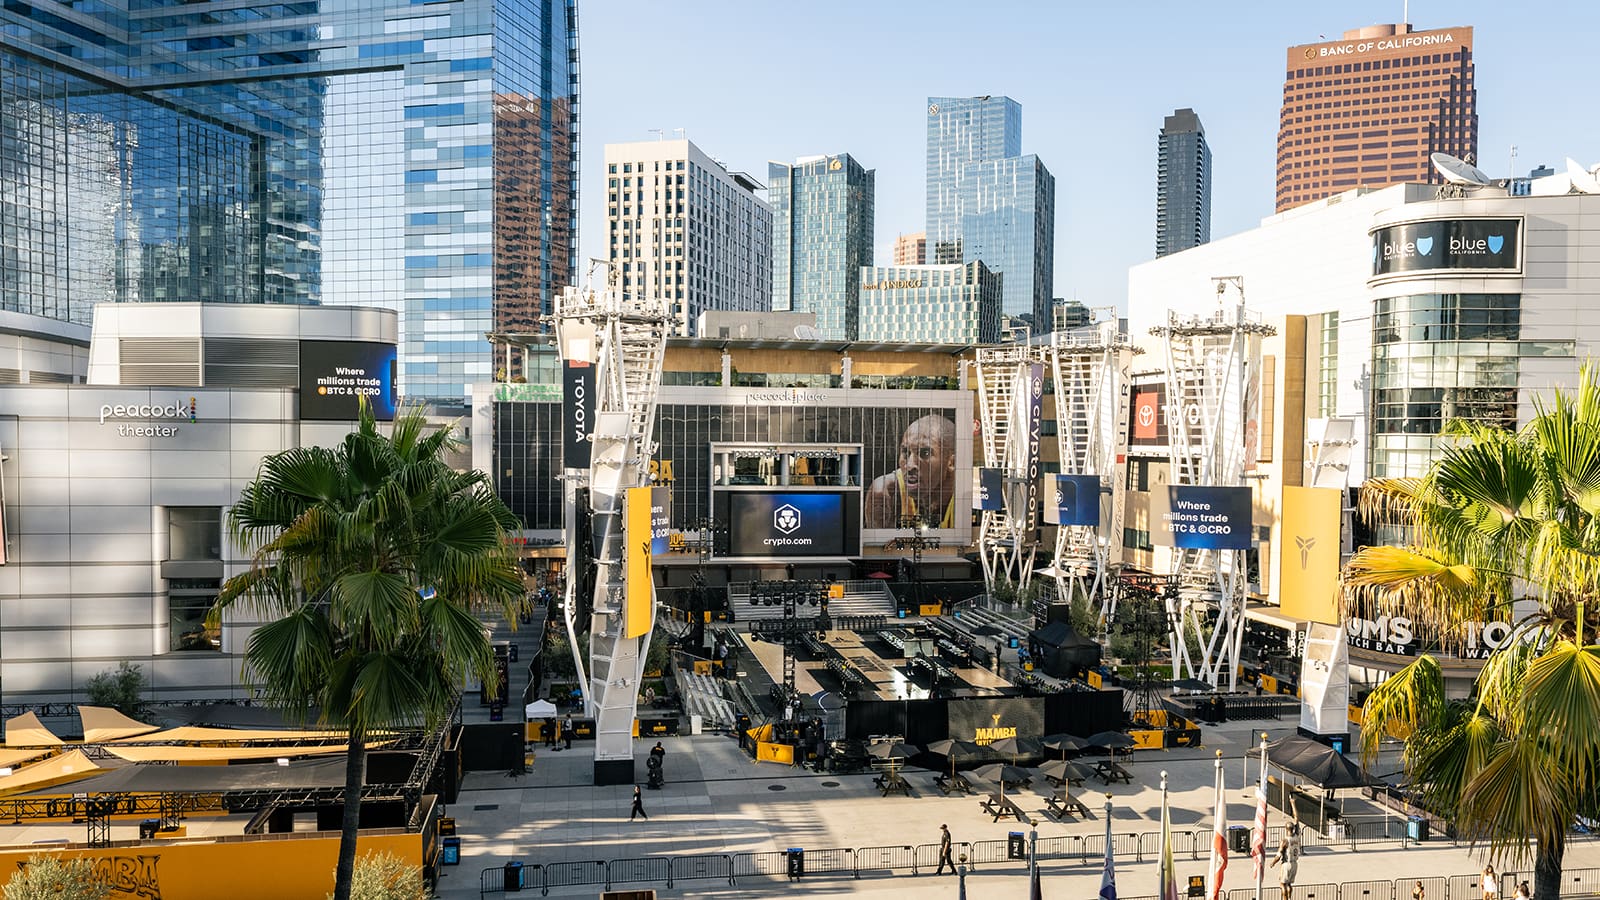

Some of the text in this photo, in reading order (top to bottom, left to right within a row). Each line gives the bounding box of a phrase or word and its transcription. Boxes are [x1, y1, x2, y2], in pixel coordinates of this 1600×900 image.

[1320, 33, 1454, 57] BANC OF CALIFORNIA
[1384, 240, 1416, 256] blue
[1449, 235, 1487, 250] blue
[887, 279, 923, 289] INDIGO
[335, 367, 366, 376] Where
[317, 376, 381, 386] millions trade
[327, 386, 346, 396] BTC
[346, 386, 354, 395] &
[746, 390, 828, 405] peacock place
[99, 399, 188, 425] peacock
[574, 375, 585, 443] TOYOTA
[1118, 364, 1129, 447] ULTRA
[118, 423, 178, 437] theater
[1027, 404, 1040, 532] crypto.com
[1177, 500, 1211, 511] Where
[1162, 511, 1229, 523] millions trade
[1168, 523, 1188, 533] BTC
[1188, 524, 1197, 534] &
[763, 537, 813, 547] crypto.com
[1375, 641, 1405, 655] BAR
[974, 727, 1018, 741] MAMBA
